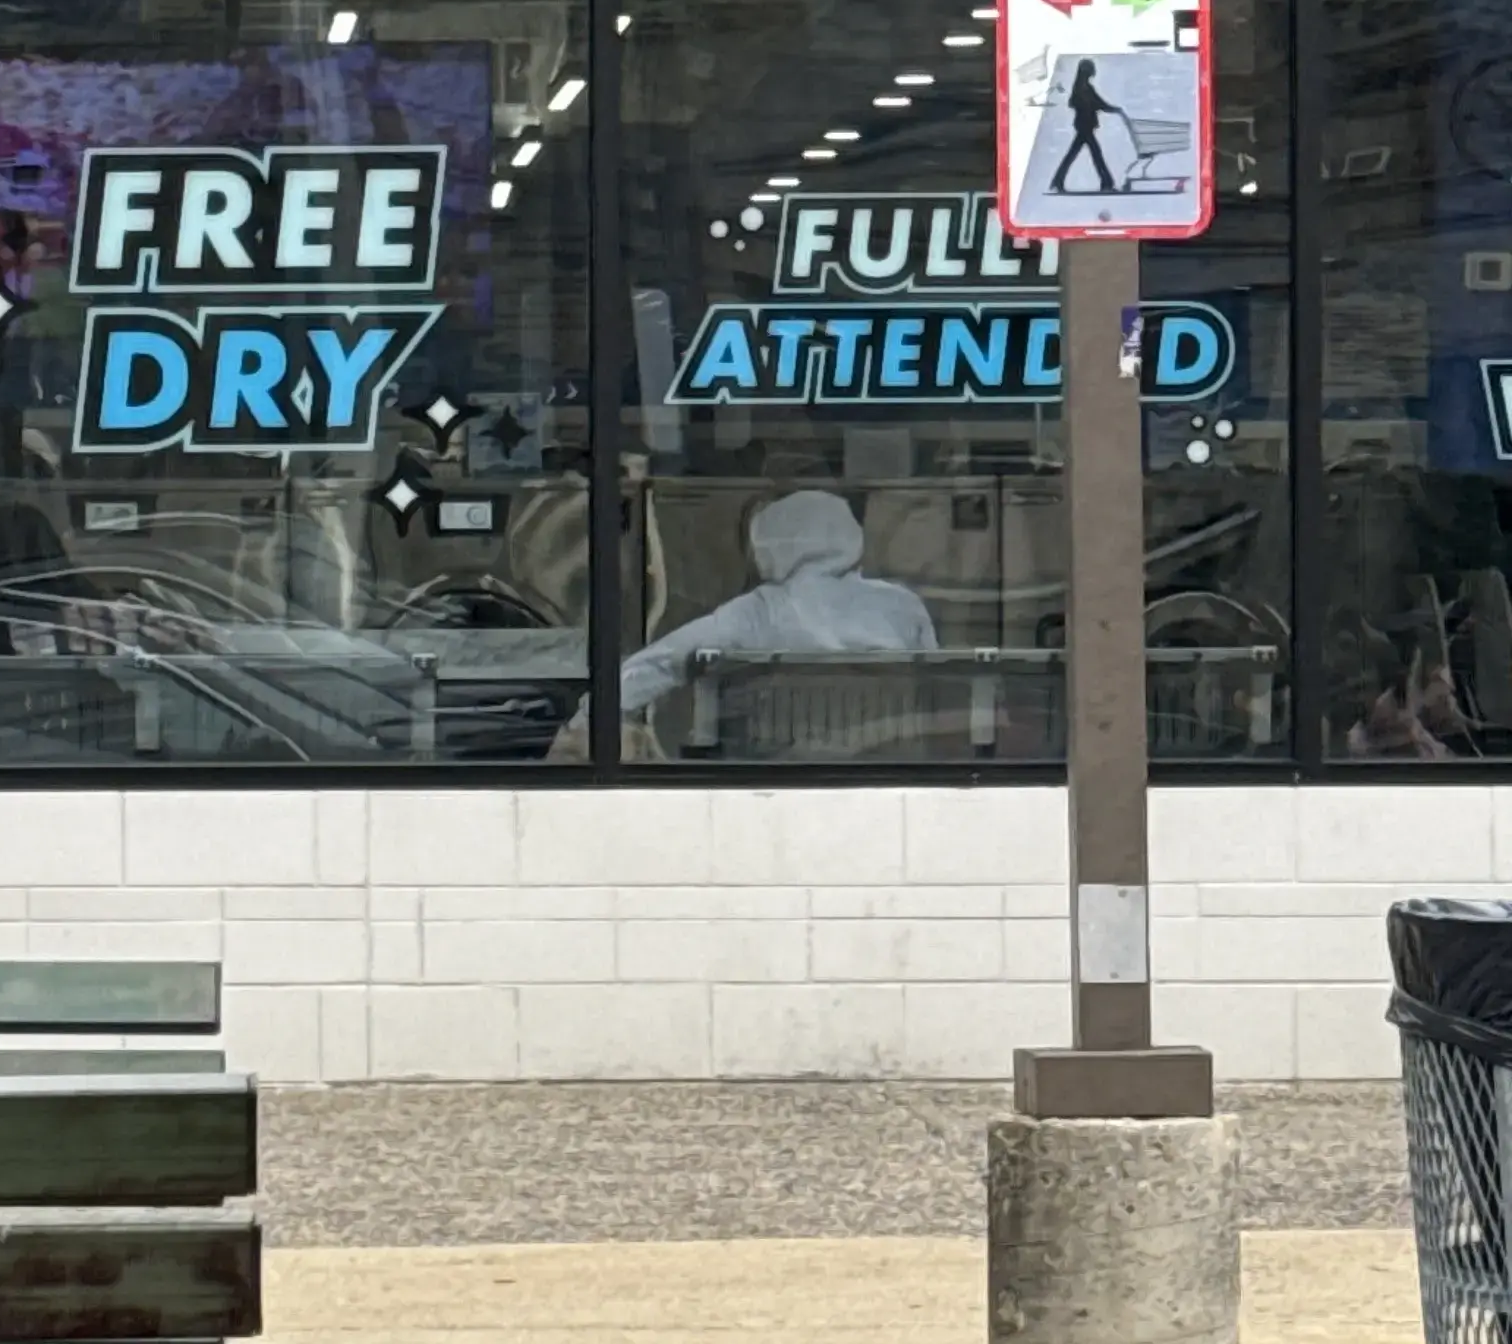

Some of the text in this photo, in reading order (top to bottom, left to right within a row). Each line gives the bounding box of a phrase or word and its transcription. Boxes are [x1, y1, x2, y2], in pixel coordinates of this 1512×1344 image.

[95, 168, 421, 269] FREE
[98, 328, 397, 429] DRY
[690, 317, 1219, 388] ATTENDD
